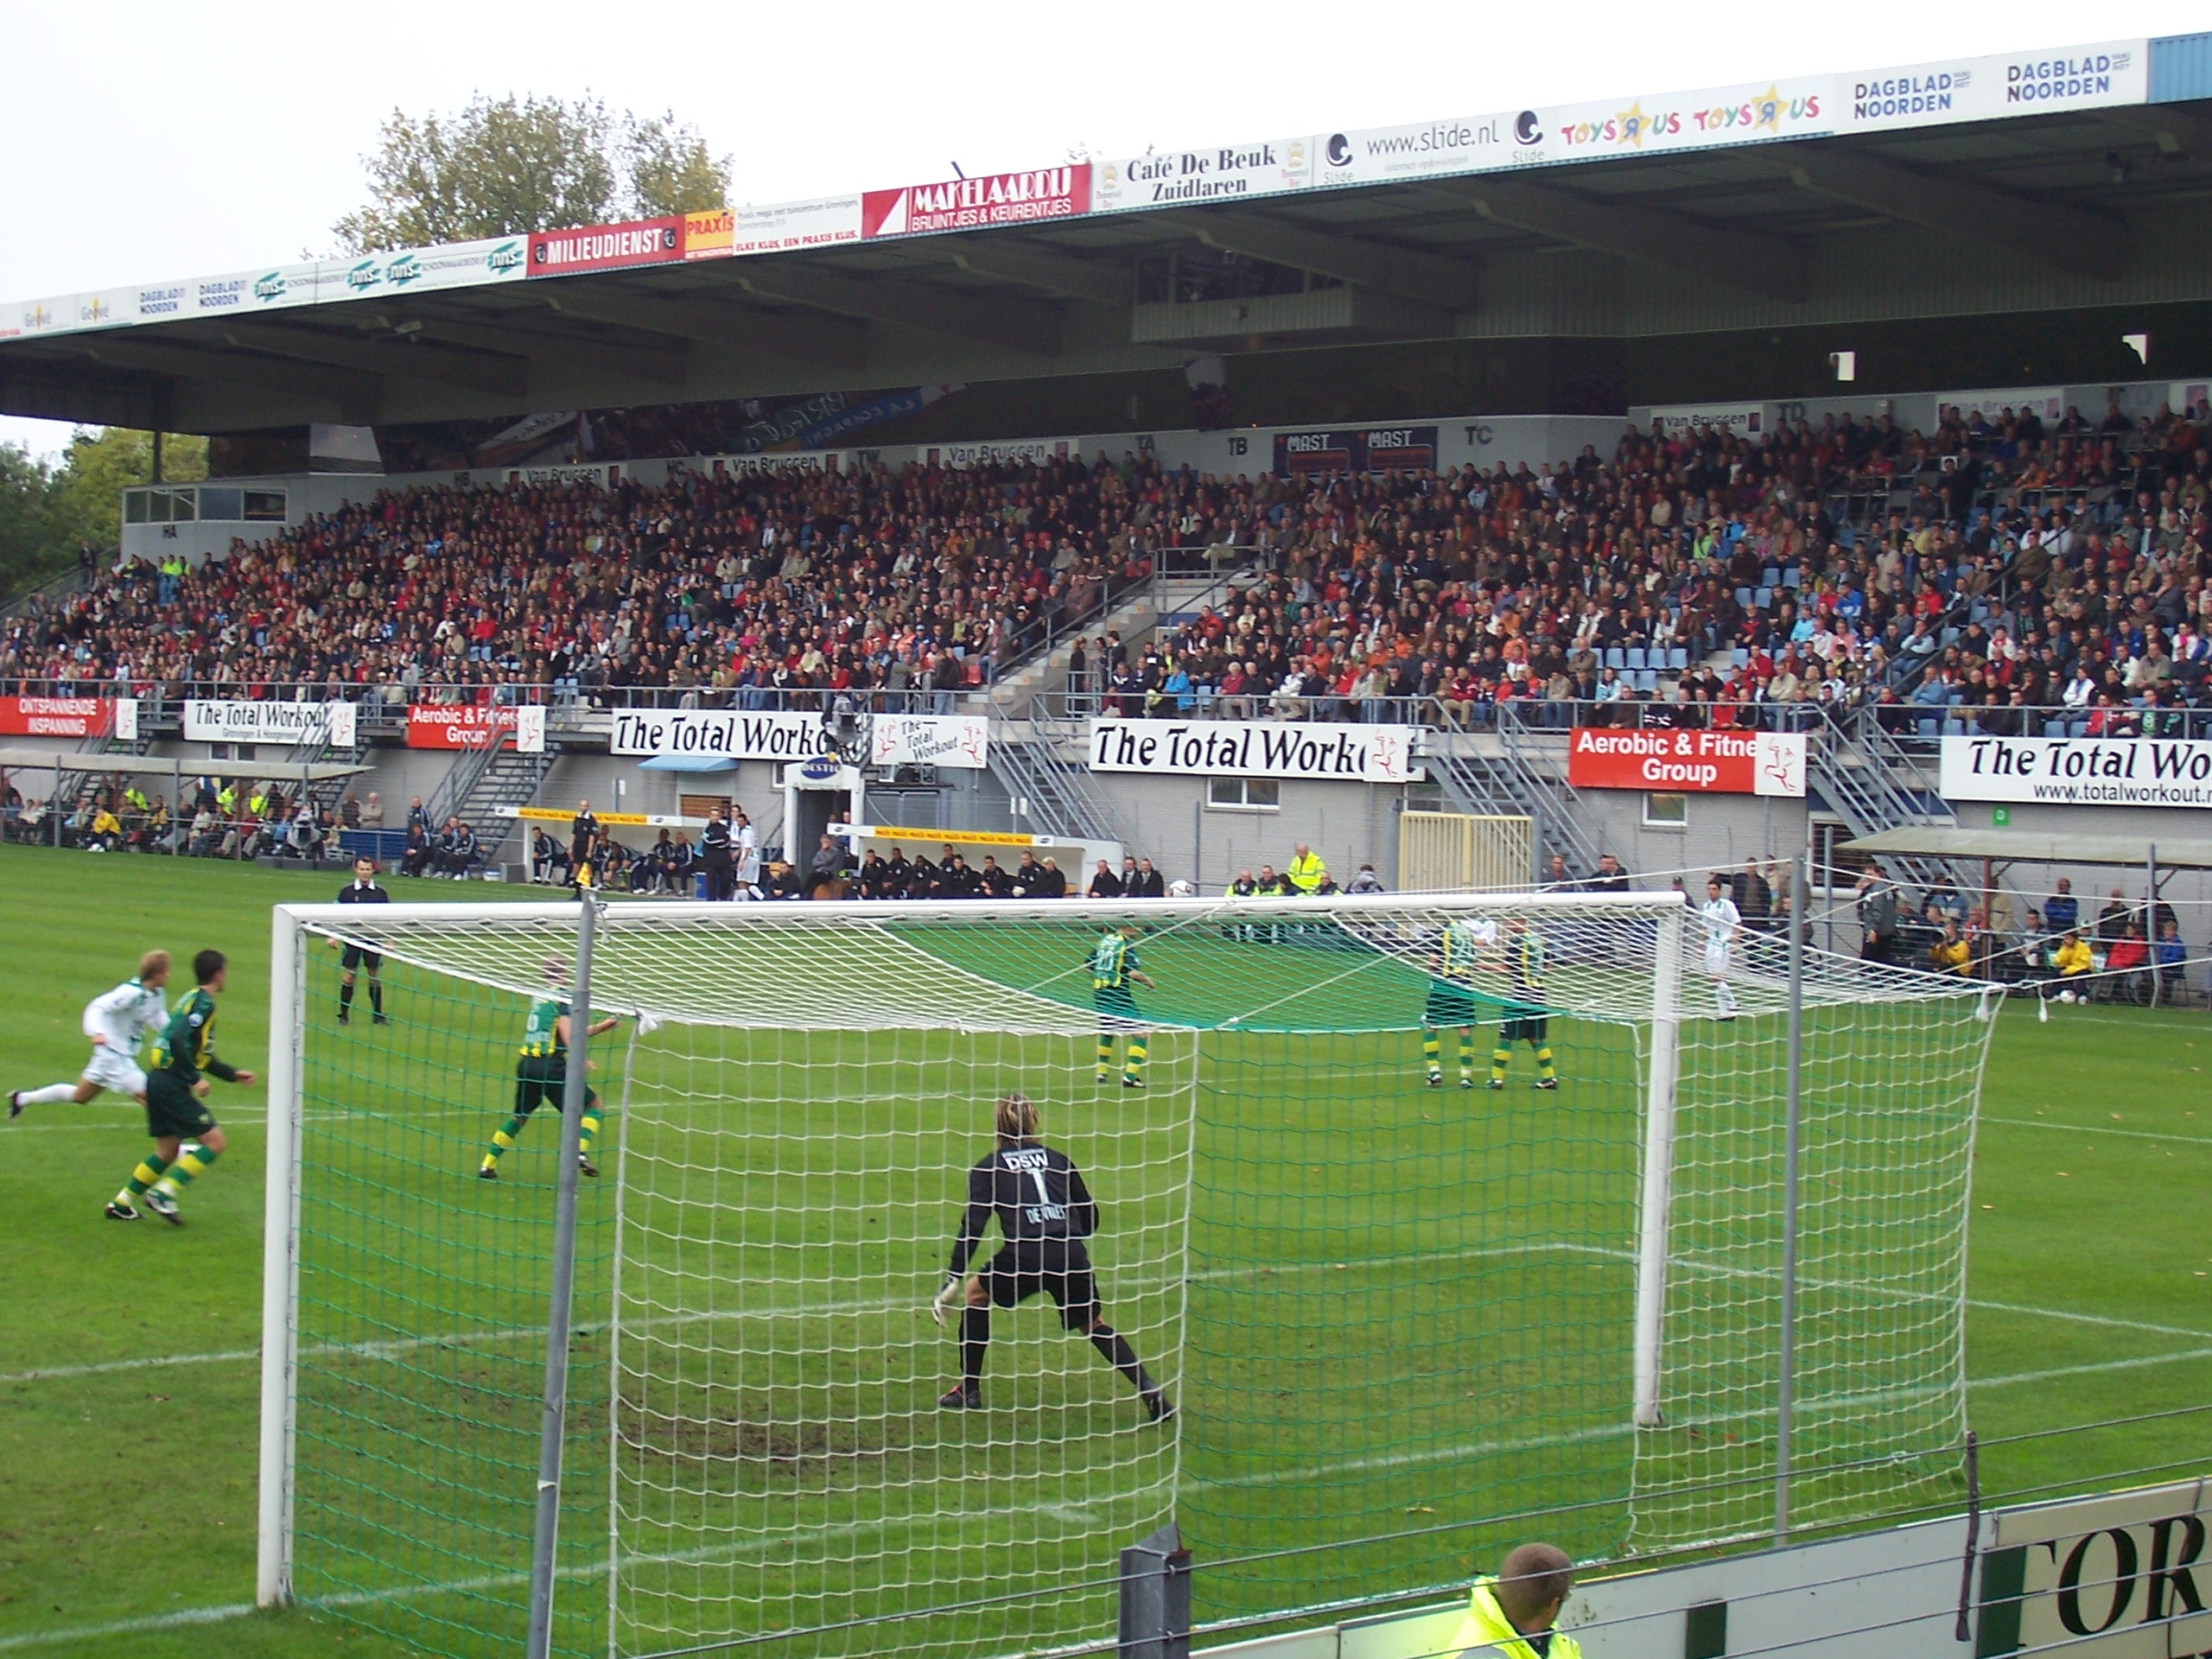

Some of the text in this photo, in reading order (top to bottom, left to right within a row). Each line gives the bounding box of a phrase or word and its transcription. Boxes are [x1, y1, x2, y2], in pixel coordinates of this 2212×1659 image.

[2007, 55, 2110, 82] DAGBLAD
[1855, 73, 1951, 100] DAGBLAD
[2007, 76, 2110, 103] NOORDEN
[1694, 104, 1751, 130] TOYS
[1789, 95, 1820, 119] US
[1854, 93, 1951, 119] NOORDEN
[1367, 120, 1500, 156] www.slide.nl
[1561, 119, 1617, 145] TOYS
[1652, 111, 1681, 135] US
[1127, 144, 1277, 182] Café De Beuk
[1512, 149, 1545, 162] Slide
[1152, 176, 1248, 201] Zuidlaren
[1324, 170, 1353, 184] Slide
[914, 168, 1072, 213] MAKELAARDIJ
[687, 217, 734, 236] PRAXIS
[912, 199, 1072, 232] BRUINTJES & KEURENTJES
[547, 227, 663, 264] MILIEUDIENST
[784, 237, 799, 247] EEN
[140, 289, 178, 302] DAGBLAD
[200, 281, 239, 295] DAGBLAD
[140, 301, 178, 314] NOORDEN
[200, 294, 239, 308] NOORDEN
[1228, 436, 1249, 455] TB
[1287, 435, 1331, 451] MAST
[1368, 430, 1414, 448] MAST
[1465, 425, 1494, 447] TC
[733, 458, 757, 473] Van
[950, 447, 976, 462] Van
[19, 697, 97, 715] ONTSPANNENDE
[195, 702, 222, 725] The
[226, 703, 260, 727] Total
[412, 706, 461, 725] Aerobic
[463, 708, 474, 724] &
[28, 717, 86, 734] INSPANNING
[617, 714, 663, 750] The
[670, 715, 735, 753] Total
[901, 720, 923, 735] The
[907, 728, 933, 748] Total
[912, 735, 958, 760] Workout
[1096, 724, 1157, 766] The
[1165, 725, 1251, 769] Total
[1577, 731, 1669, 755] Aerobic
[1675, 734, 1693, 756] &
[1968, 739, 2037, 776] The
[2045, 741, 2139, 779] Total
[1643, 758, 1718, 787] Group
[1005, 1153, 1048, 1170] DSW
[1027, 1168, 1050, 1205] 1
